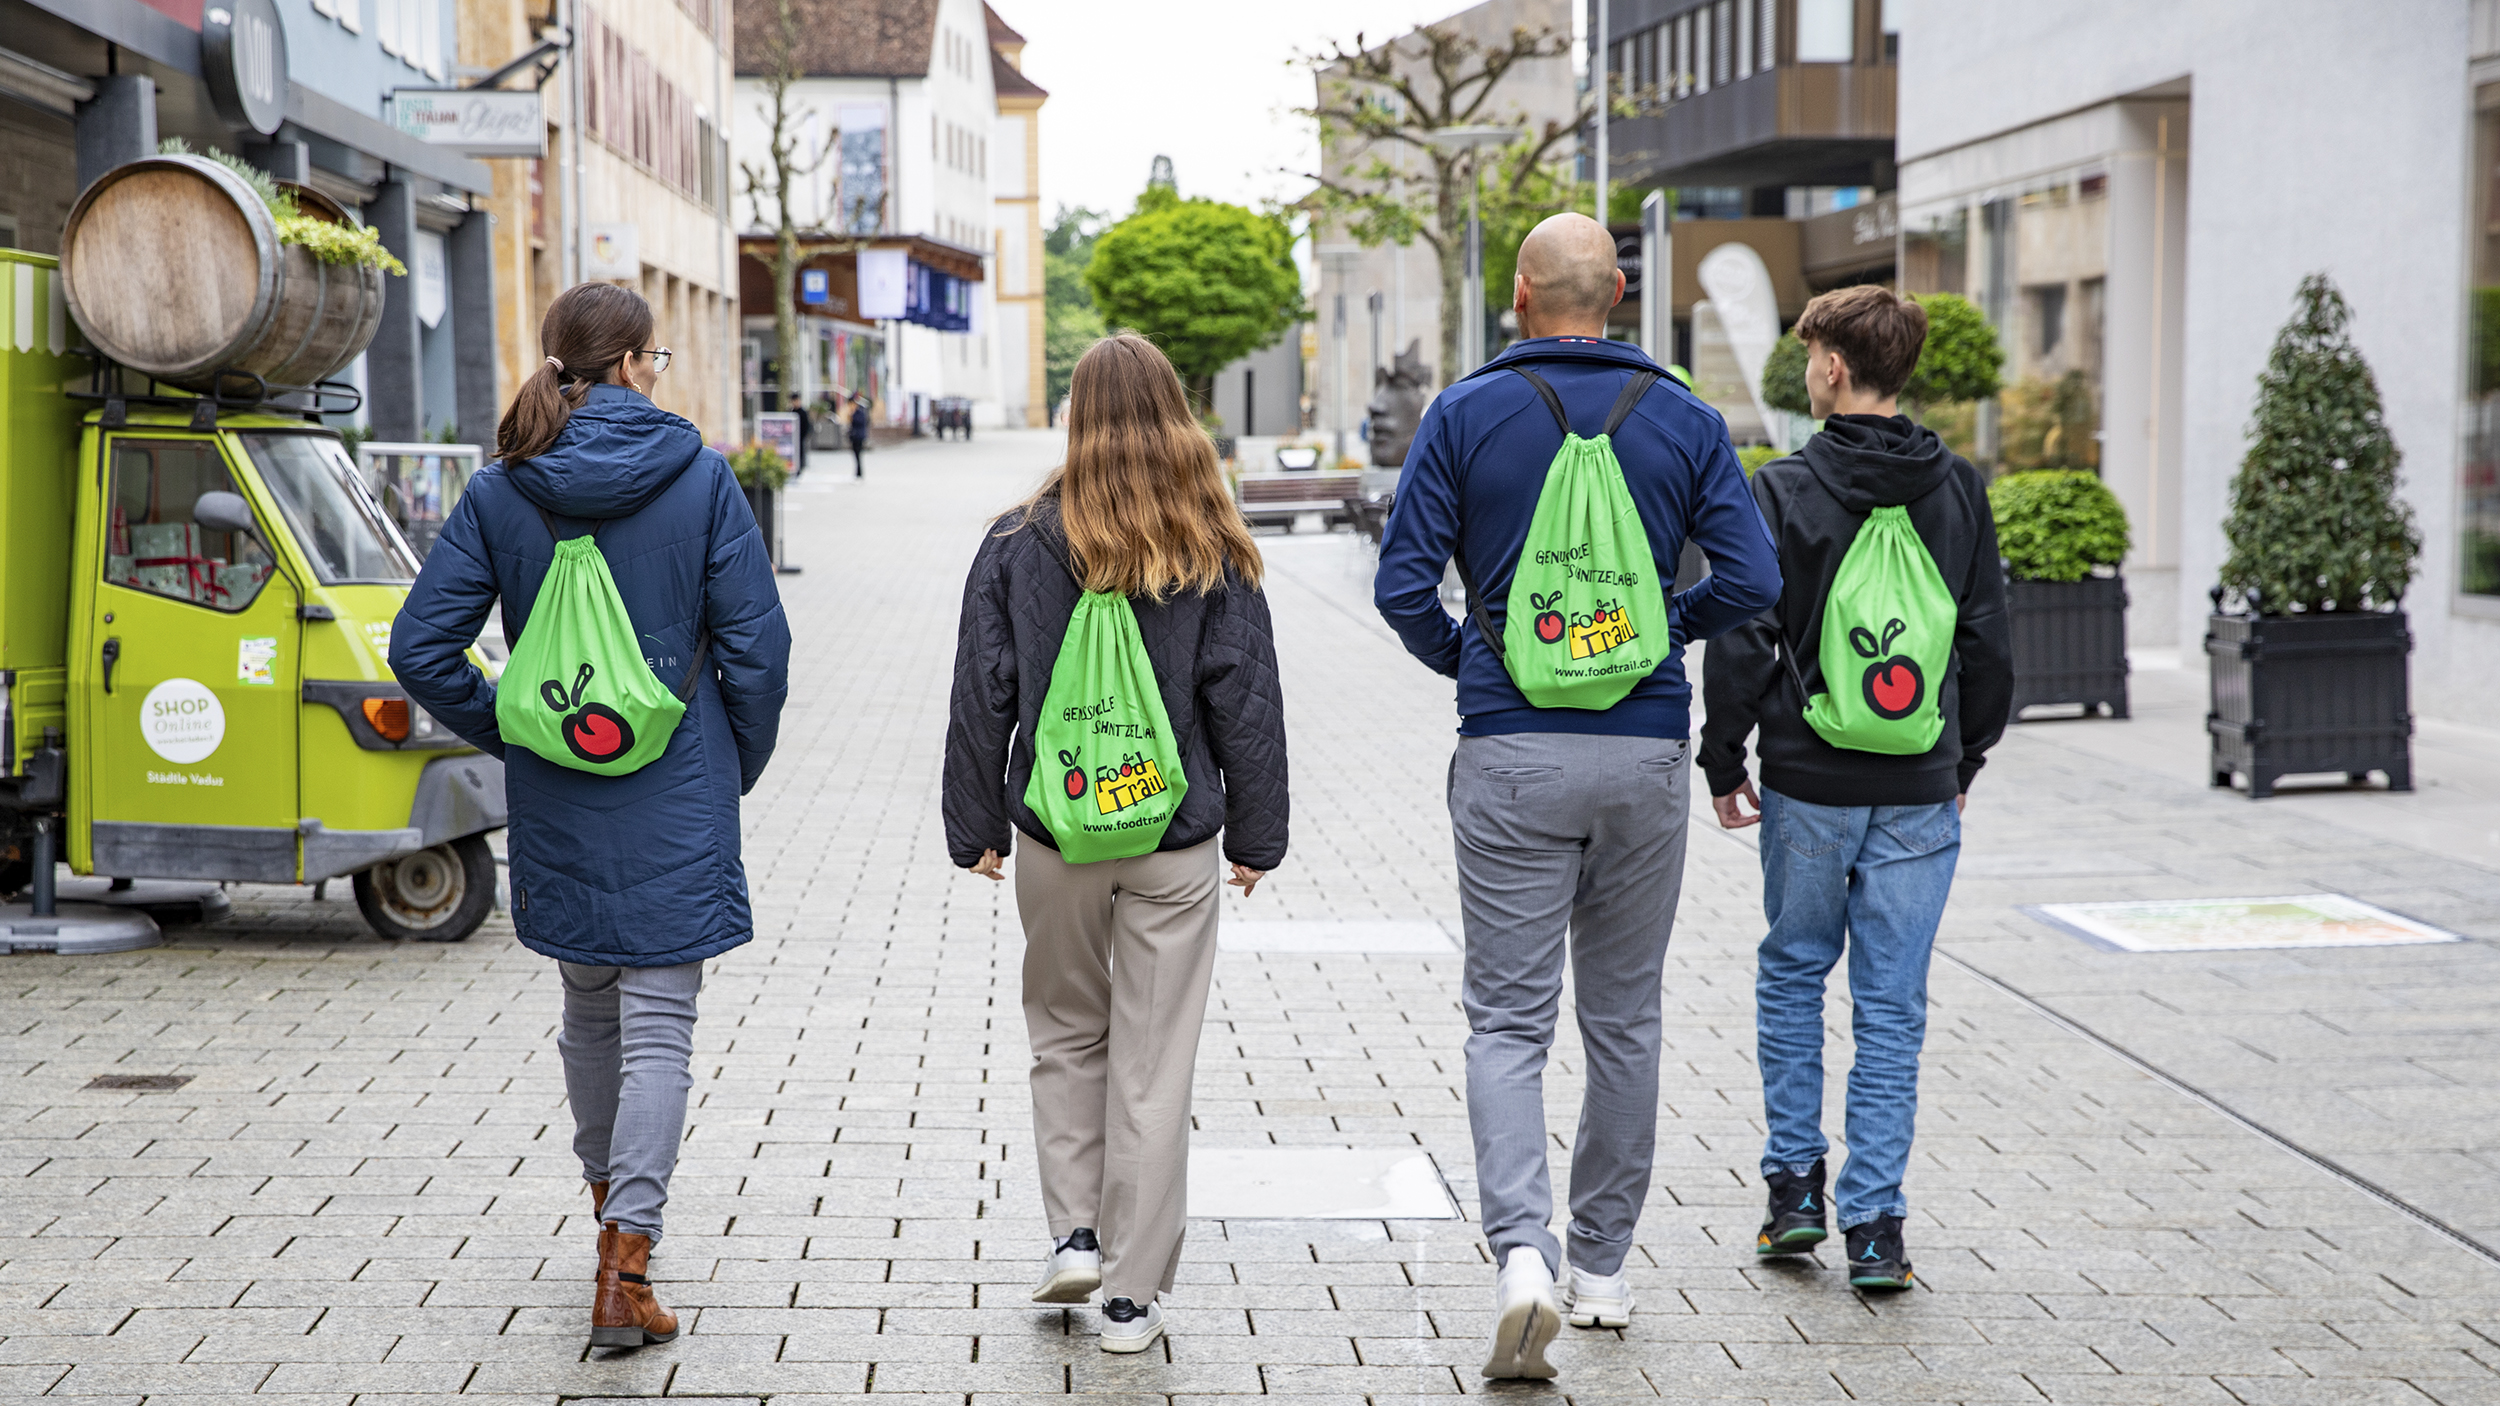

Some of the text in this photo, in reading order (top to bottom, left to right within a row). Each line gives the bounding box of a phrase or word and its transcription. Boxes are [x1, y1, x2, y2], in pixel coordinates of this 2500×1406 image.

[1570, 598, 1620, 639] Food
[1581, 622, 1640, 658] Trail
[646, 656, 677, 668] EIN
[1554, 657, 1653, 677] www.foodtrail.ch
[153, 699, 209, 717] SHOP
[154, 718, 212, 734] Online
[146, 770, 224, 787] Städtle Vaduz
[1096, 751, 1147, 793] Food
[1109, 775, 1168, 812] Trail
